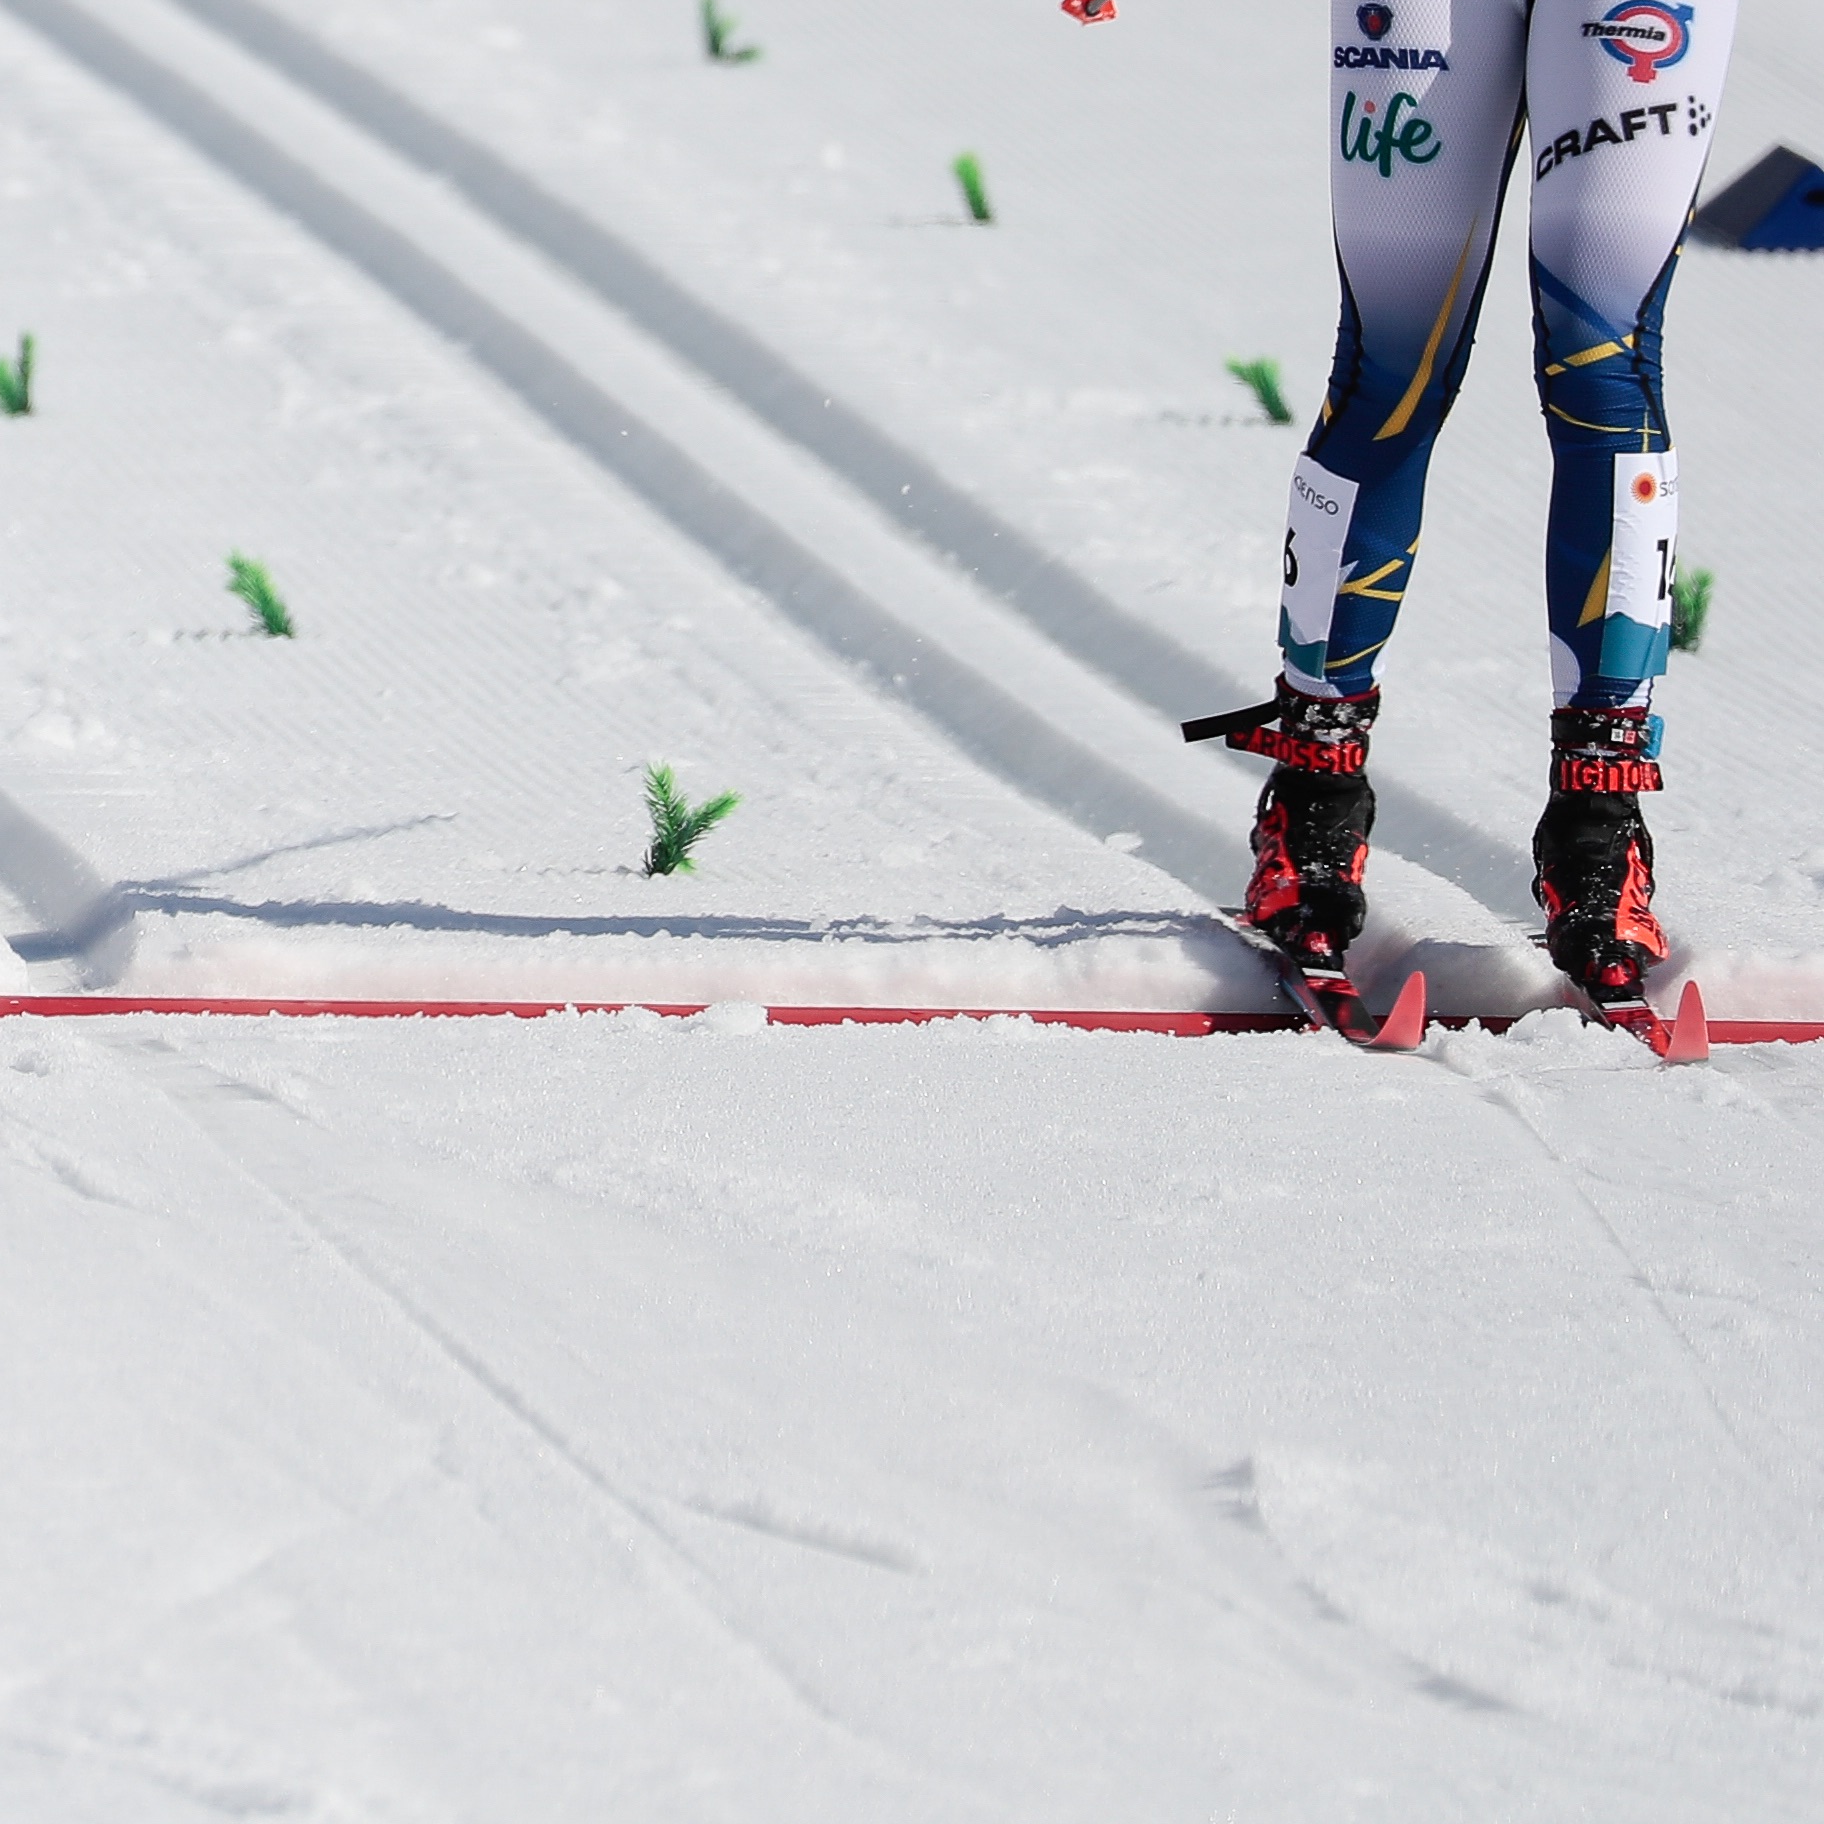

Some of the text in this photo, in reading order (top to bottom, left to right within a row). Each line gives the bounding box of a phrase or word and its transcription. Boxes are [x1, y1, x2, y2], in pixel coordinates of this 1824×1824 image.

[1581, 21, 1667, 43] Thermia
[1334, 46, 1450, 71] SCANIA
[1340, 91, 1442, 177] life
[1536, 103, 1678, 181] CRAFT
